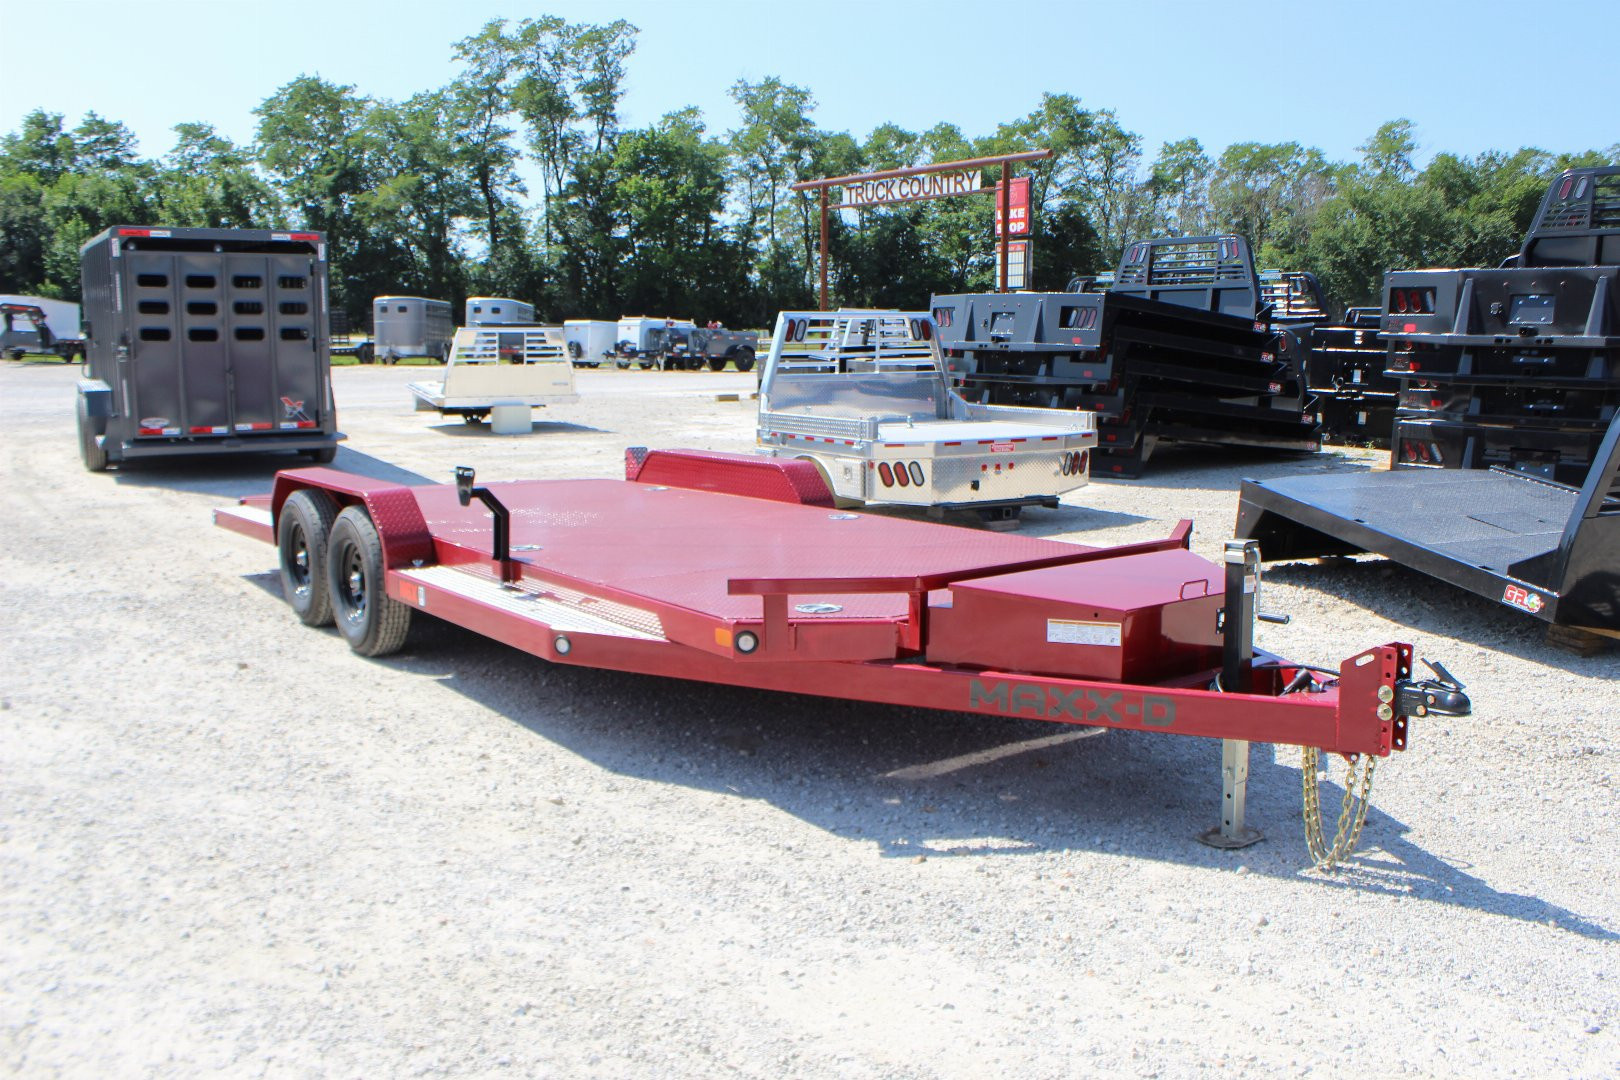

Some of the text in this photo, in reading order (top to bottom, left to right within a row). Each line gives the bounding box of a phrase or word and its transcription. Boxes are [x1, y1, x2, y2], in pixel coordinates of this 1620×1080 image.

[845, 171, 977, 204] TRUCK COUNTRY
[997, 207, 1025, 220] LKE
[996, 221, 1025, 234] SOP
[970, 679, 1176, 727] MAXX-D
